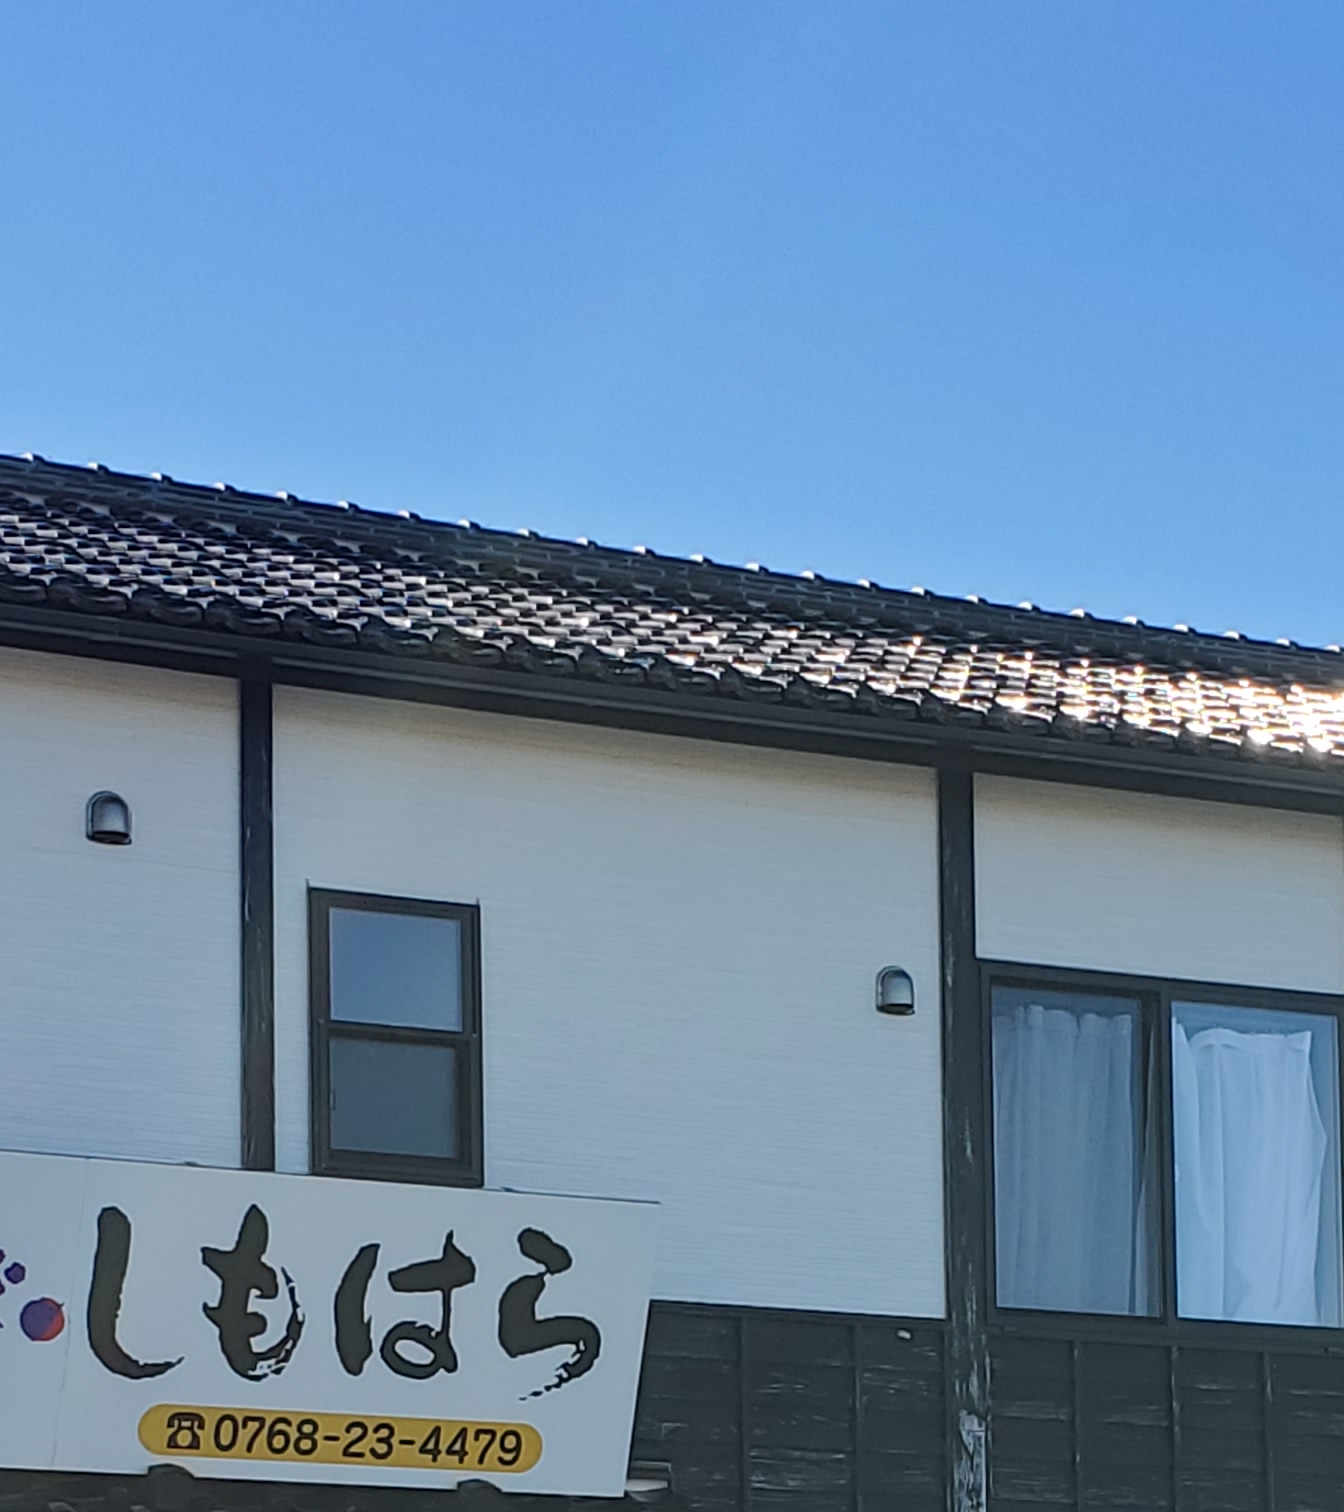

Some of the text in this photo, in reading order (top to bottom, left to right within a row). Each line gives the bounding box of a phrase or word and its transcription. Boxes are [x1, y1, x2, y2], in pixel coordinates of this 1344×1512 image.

[87, 1202, 603, 1402] しもはら
[213, 1413, 523, 1470] 0768-23-4479
